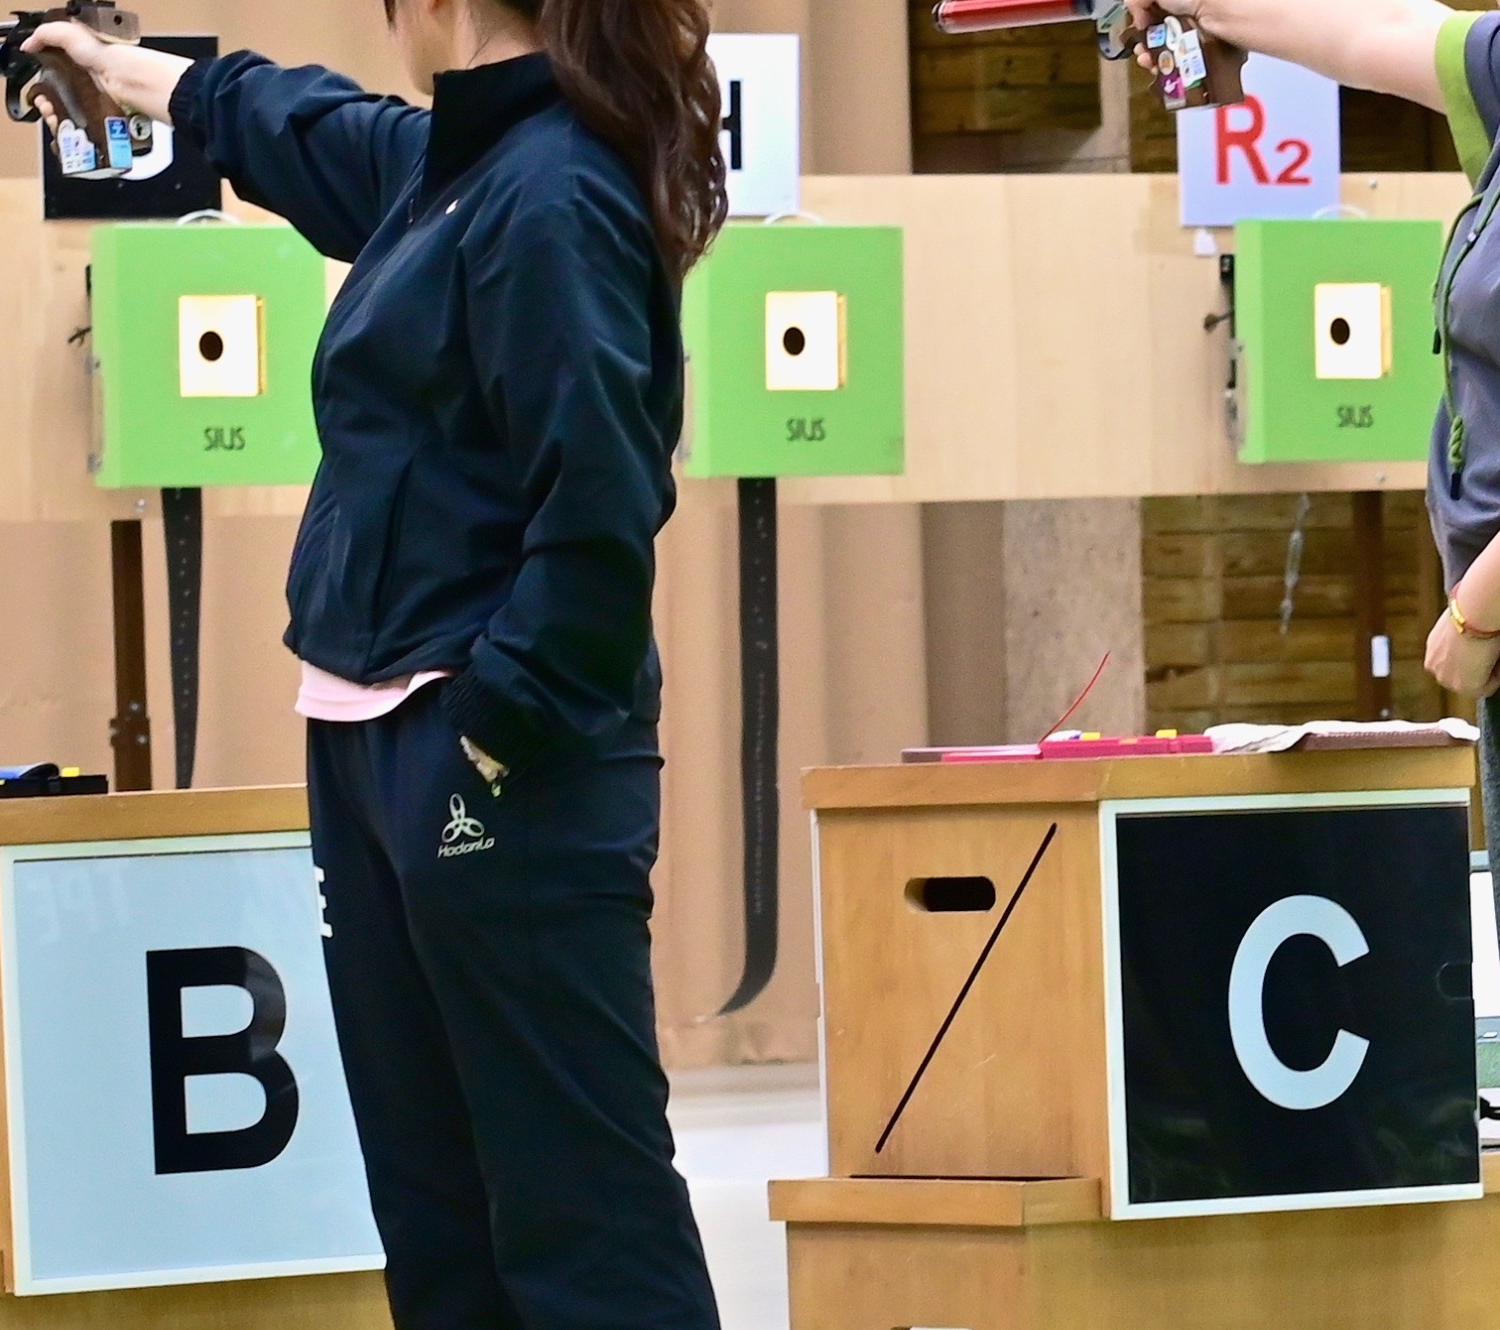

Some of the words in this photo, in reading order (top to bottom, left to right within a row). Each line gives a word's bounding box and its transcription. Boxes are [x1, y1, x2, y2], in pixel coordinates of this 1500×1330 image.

[786, 418, 826, 442] SIUS
[1338, 406, 1374, 429] SIUS
[204, 426, 246, 452] SIUS
[1228, 895, 1370, 1110] C
[145, 945, 301, 1176] B
